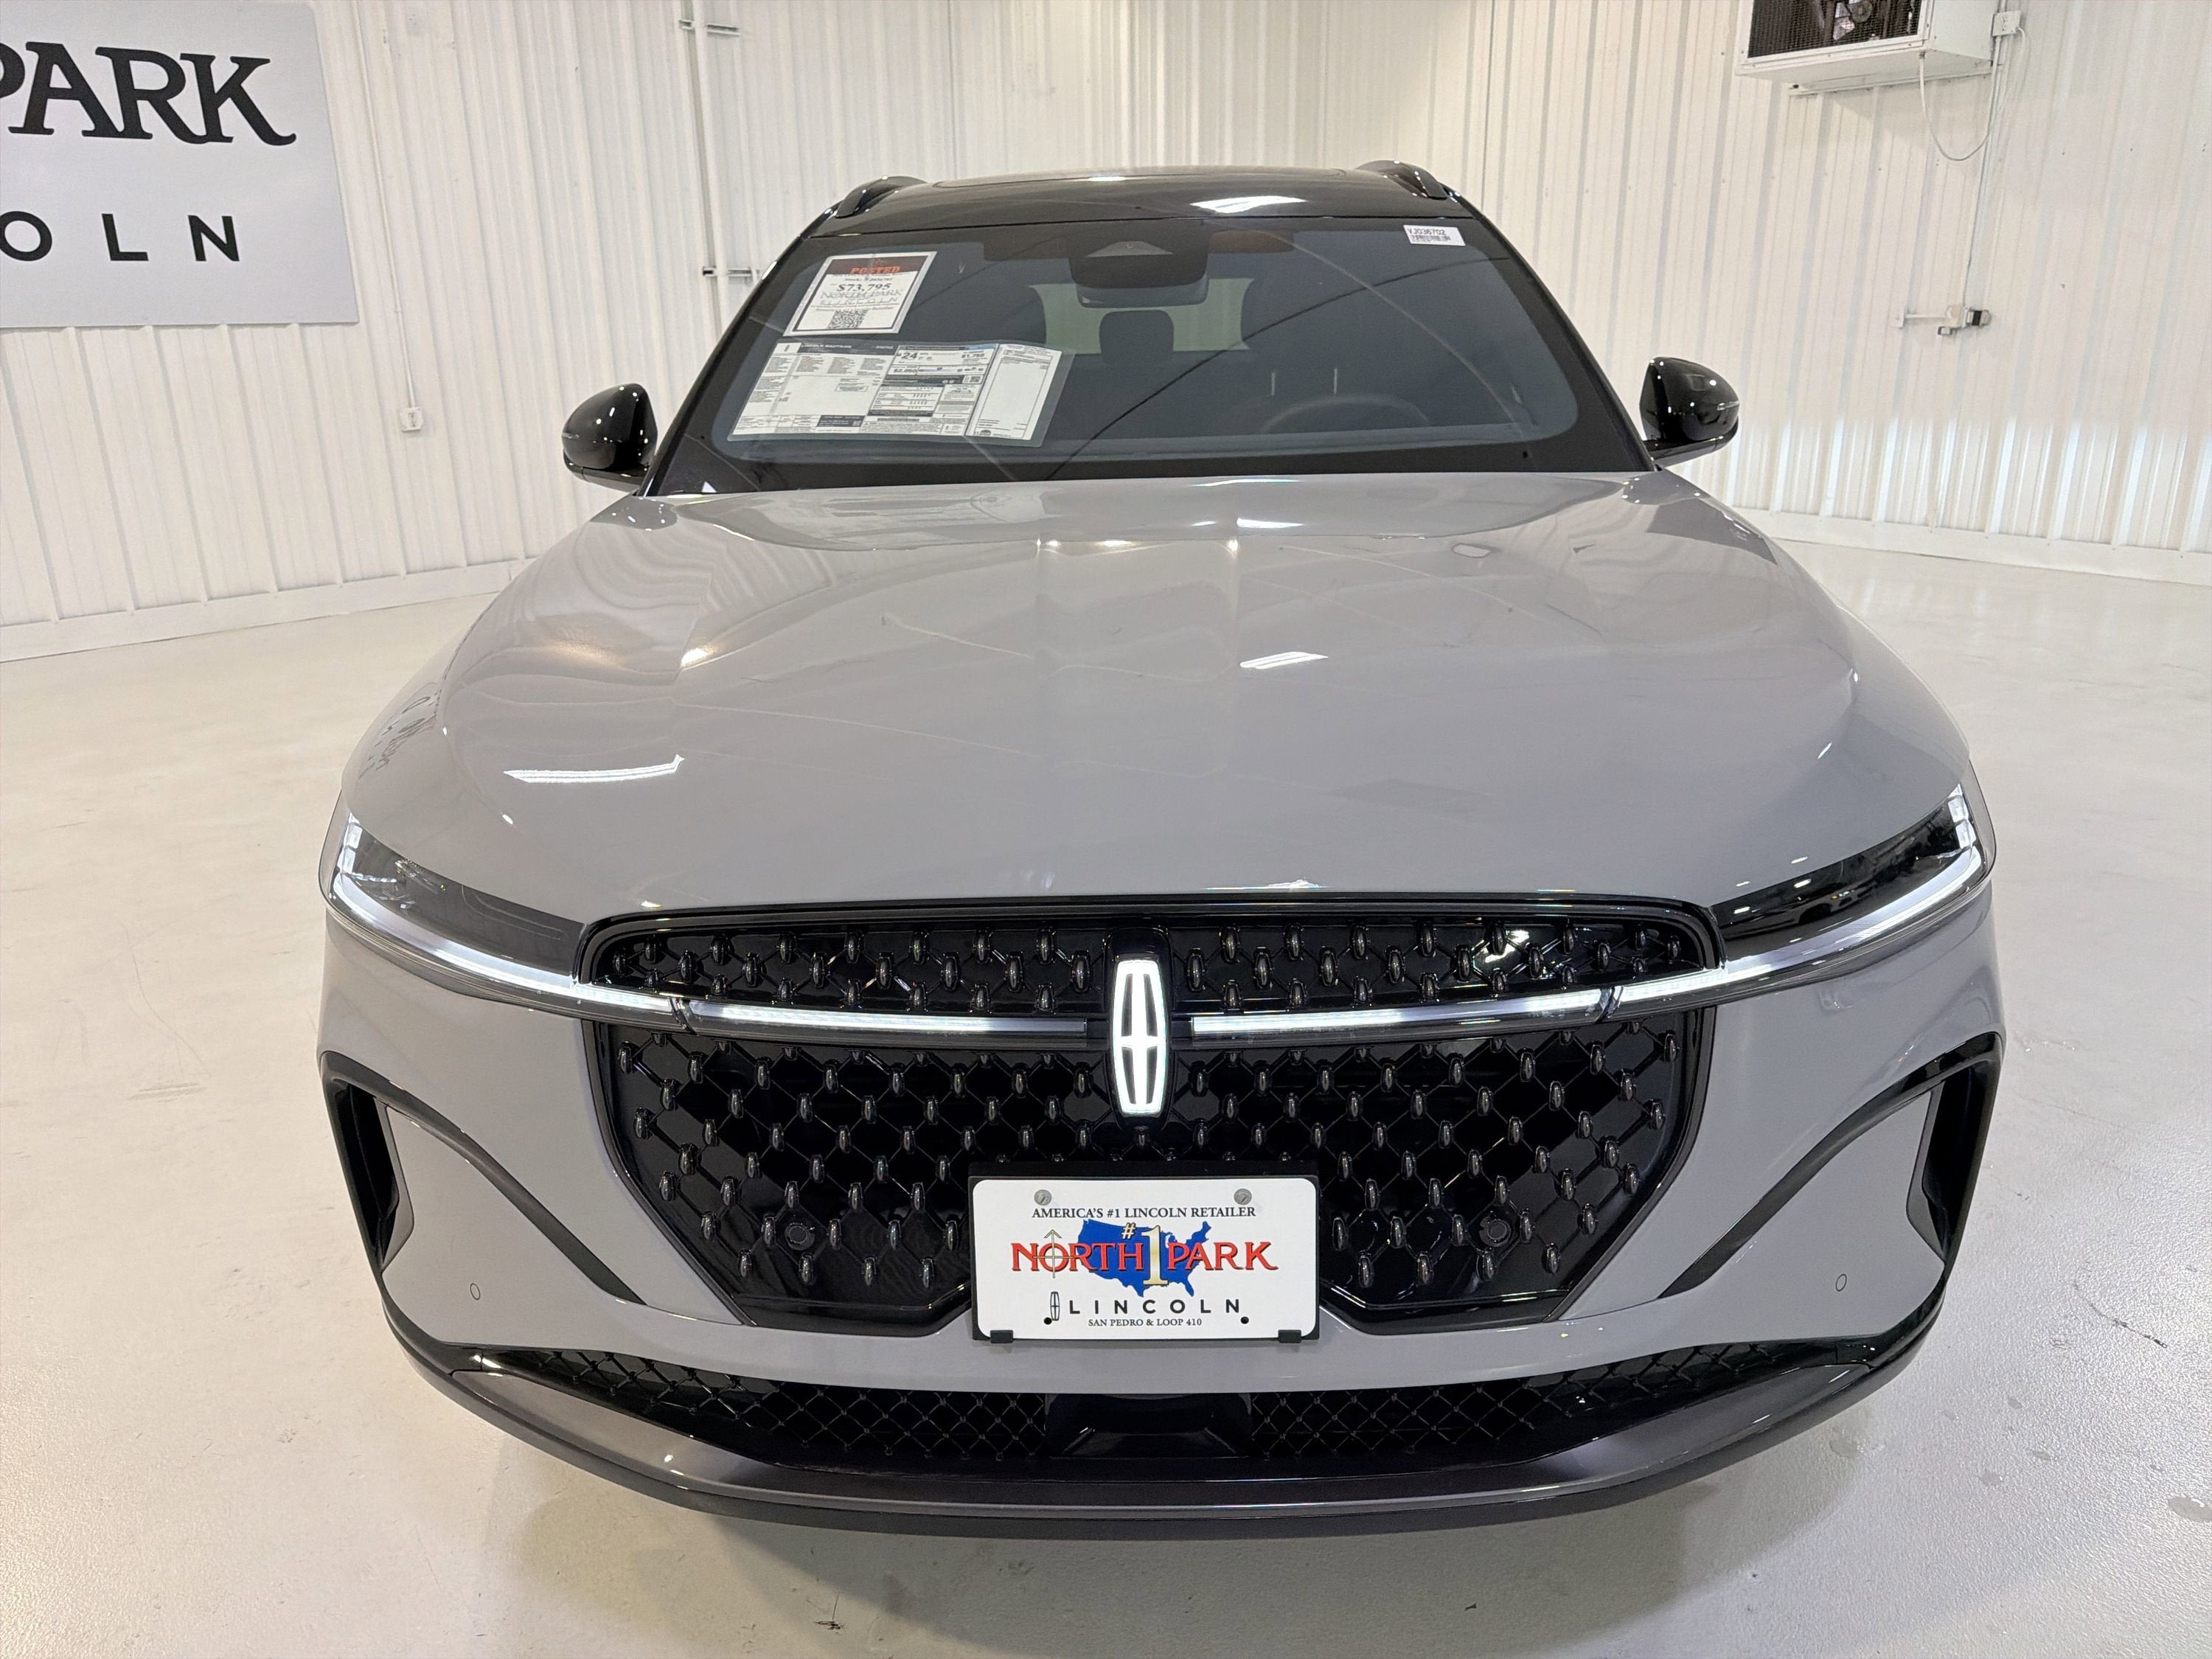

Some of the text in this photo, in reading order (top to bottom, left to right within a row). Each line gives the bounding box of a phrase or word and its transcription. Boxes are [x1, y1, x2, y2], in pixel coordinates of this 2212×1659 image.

[901, 352, 918, 360] 24
[1032, 1206, 1257, 1218] AMERICA'S #1 LINCOLN RETAILER
[1011, 1241, 1279, 1272] NORTH PARK
[1069, 1298, 1239, 1315] LINCOLN
[1088, 1318, 1203, 1327] SAN PEDRO & LOOP 410
